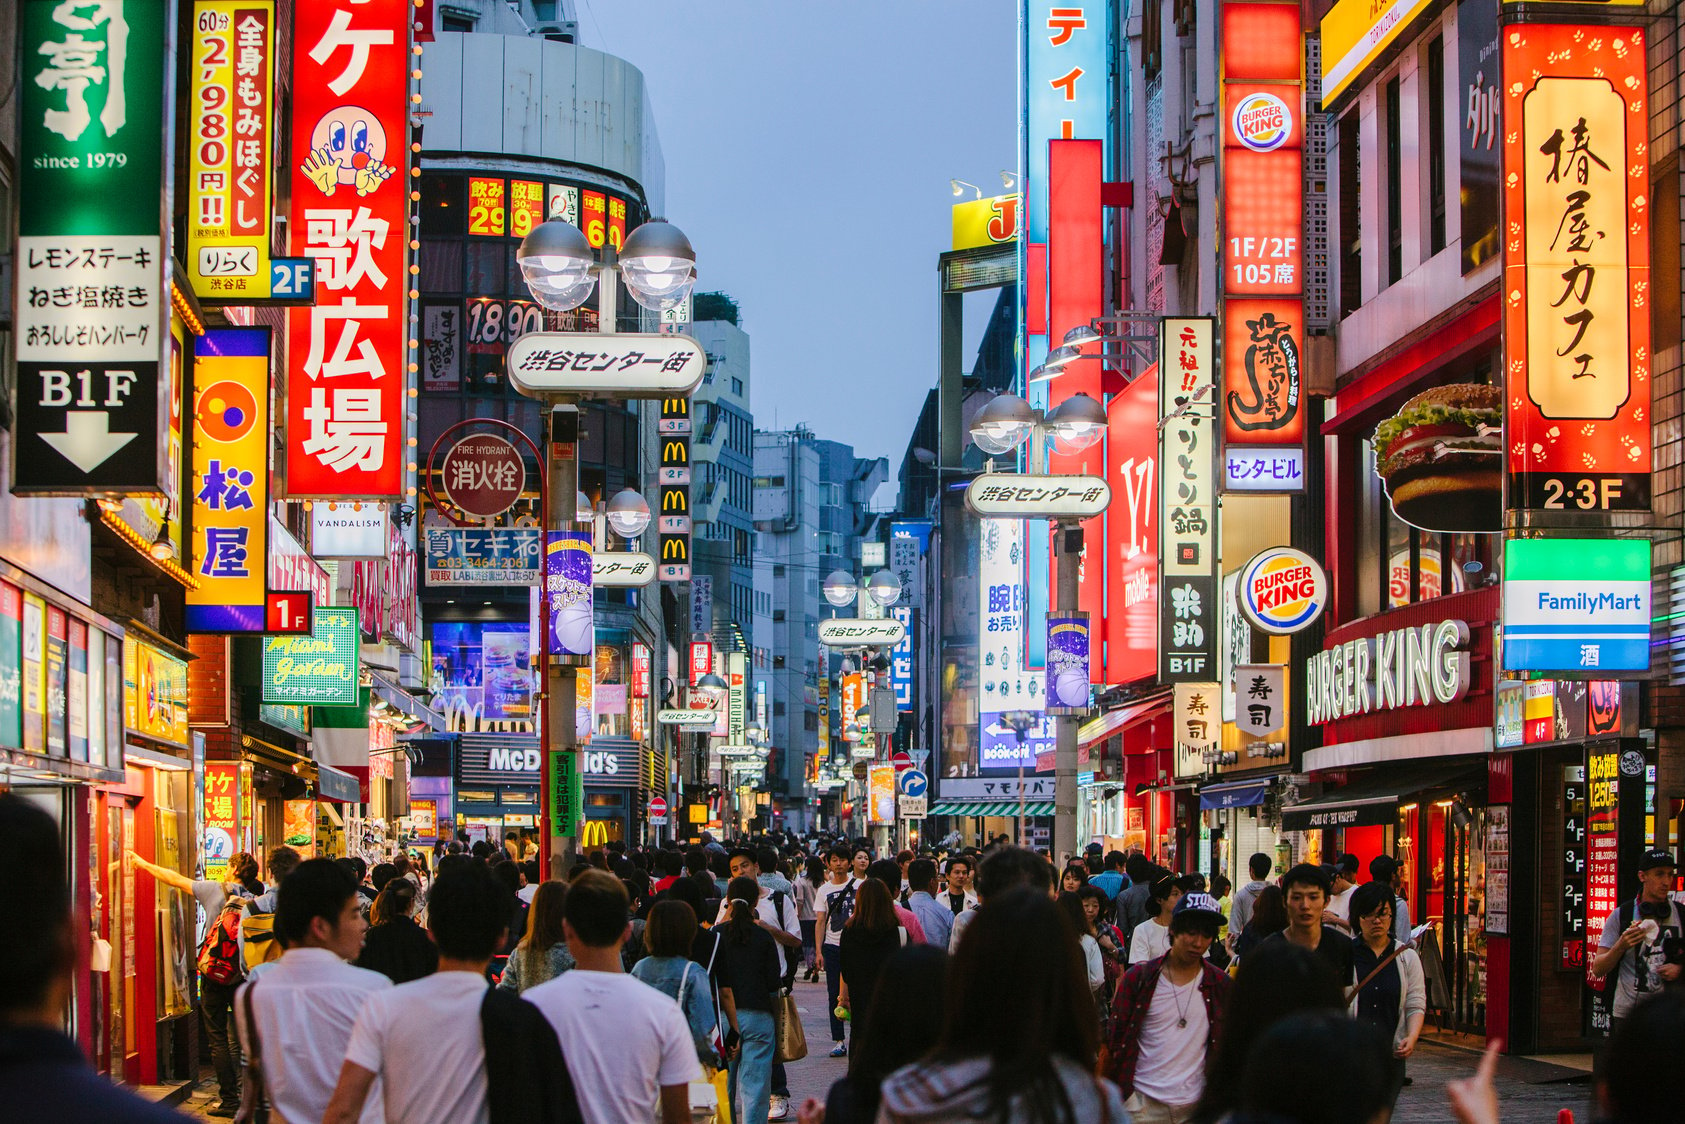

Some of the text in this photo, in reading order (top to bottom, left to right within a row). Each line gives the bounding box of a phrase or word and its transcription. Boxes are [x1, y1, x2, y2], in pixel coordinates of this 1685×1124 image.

[198, 11, 230, 33] 60分
[235, 15, 265, 229] 全身もみほぐし
[1242, 106, 1282, 126] BURGER
[1243, 114, 1284, 140] KING
[33, 153, 128, 169] since 1979
[28, 247, 151, 270] レモンステーキ
[1539, 117, 1612, 381] 椿屋カフェ
[205, 252, 252, 273] りらく
[1232, 262, 1295, 286] 105席
[210, 277, 247, 291] 渋谷店
[272, 264, 310, 293] 2F
[29, 285, 149, 308] ねぎ塩焼き
[26, 325, 149, 348] おろししそハンバーグ
[302, 205, 391, 474] 歌広場
[519, 350, 694, 374] 渋谷センター街
[1281, 337, 1299, 408] とうがらし料理
[38, 369, 138, 407] B1F
[458, 446, 511, 455] FIRE HYDRANT
[451, 460, 518, 492] 消火栓
[1227, 457, 1302, 481] センタービル
[978, 486, 1105, 503] 渋谷センター街
[198, 459, 254, 578] 松屋
[1120, 456, 1155, 561] Y!
[428, 530, 453, 557] 質
[456, 530, 539, 556] セキネ
[447, 557, 529, 568] 03-3464-2061
[430, 570, 451, 581] 買取
[1125, 567, 1149, 608] mobile
[1254, 566, 1313, 593] BURGER
[1256, 578, 1317, 614] KING
[1538, 591, 1642, 615] FamilyMart
[822, 625, 900, 637] 渋谷センター街
[267, 633, 336, 655] Miami
[1579, 643, 1601, 667] 酒
[1169, 658, 1206, 673] B1F
[1306, 635, 1370, 727] BURGER
[1374, 619, 1471, 712] KING
[273, 686, 343, 697] マイアミガーデン
[1247, 674, 1273, 728] 寿司
[1187, 693, 1209, 740] 寿司
[1535, 722, 1545, 739] 4F
[489, 748, 619, 775] McDld's
[1588, 753, 1618, 780] 飲み放題
[555, 754, 570, 834] 客引きは犯罪です
